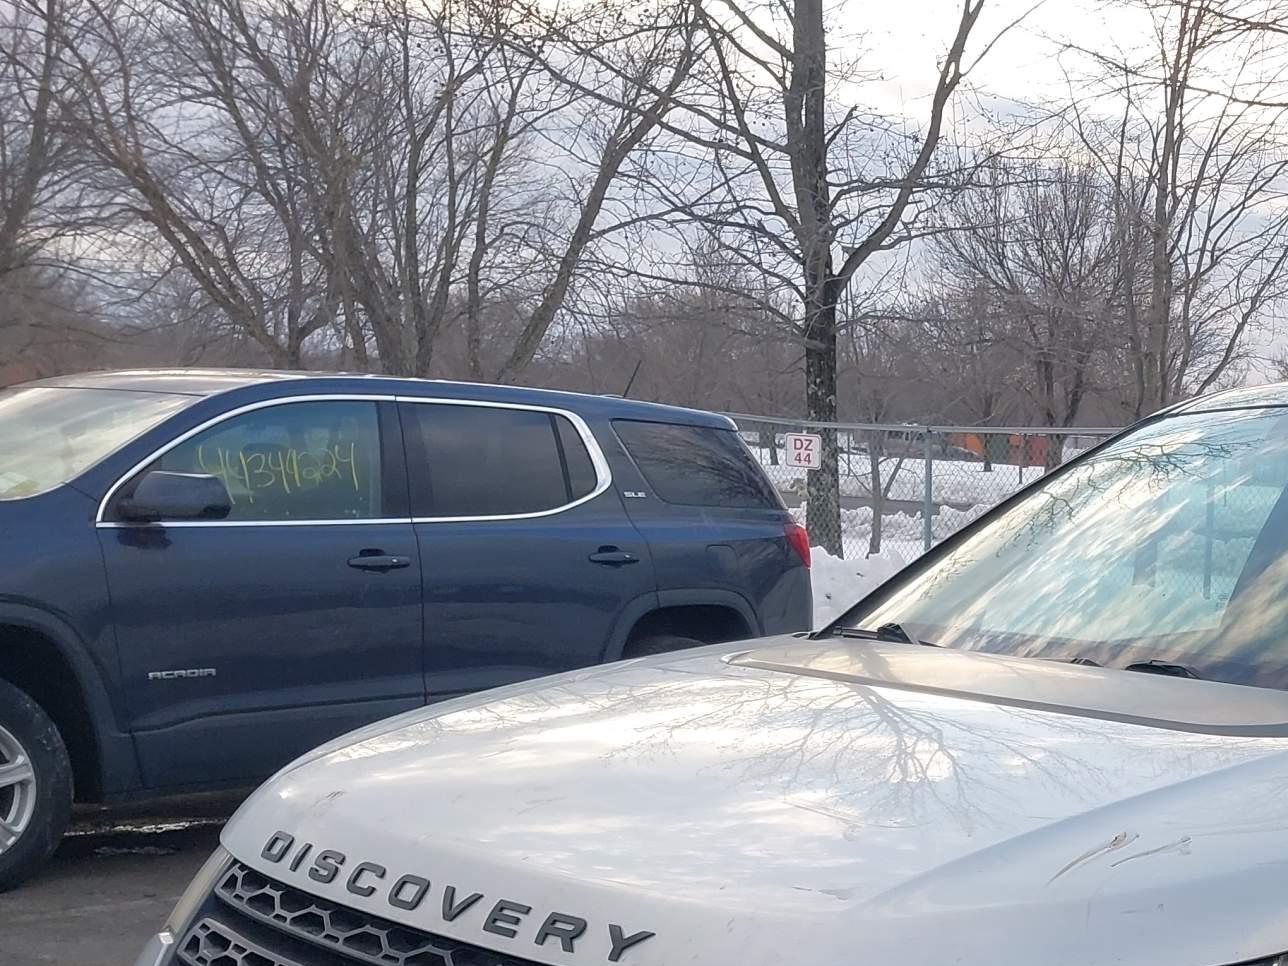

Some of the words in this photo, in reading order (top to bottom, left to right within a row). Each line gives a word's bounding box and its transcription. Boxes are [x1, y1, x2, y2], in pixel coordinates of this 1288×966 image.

[793, 438, 814, 452] DZ
[793, 451, 812, 465] 44
[147, 668, 217, 680] ACADIA
[260, 829, 657, 963] DISCOVERY
